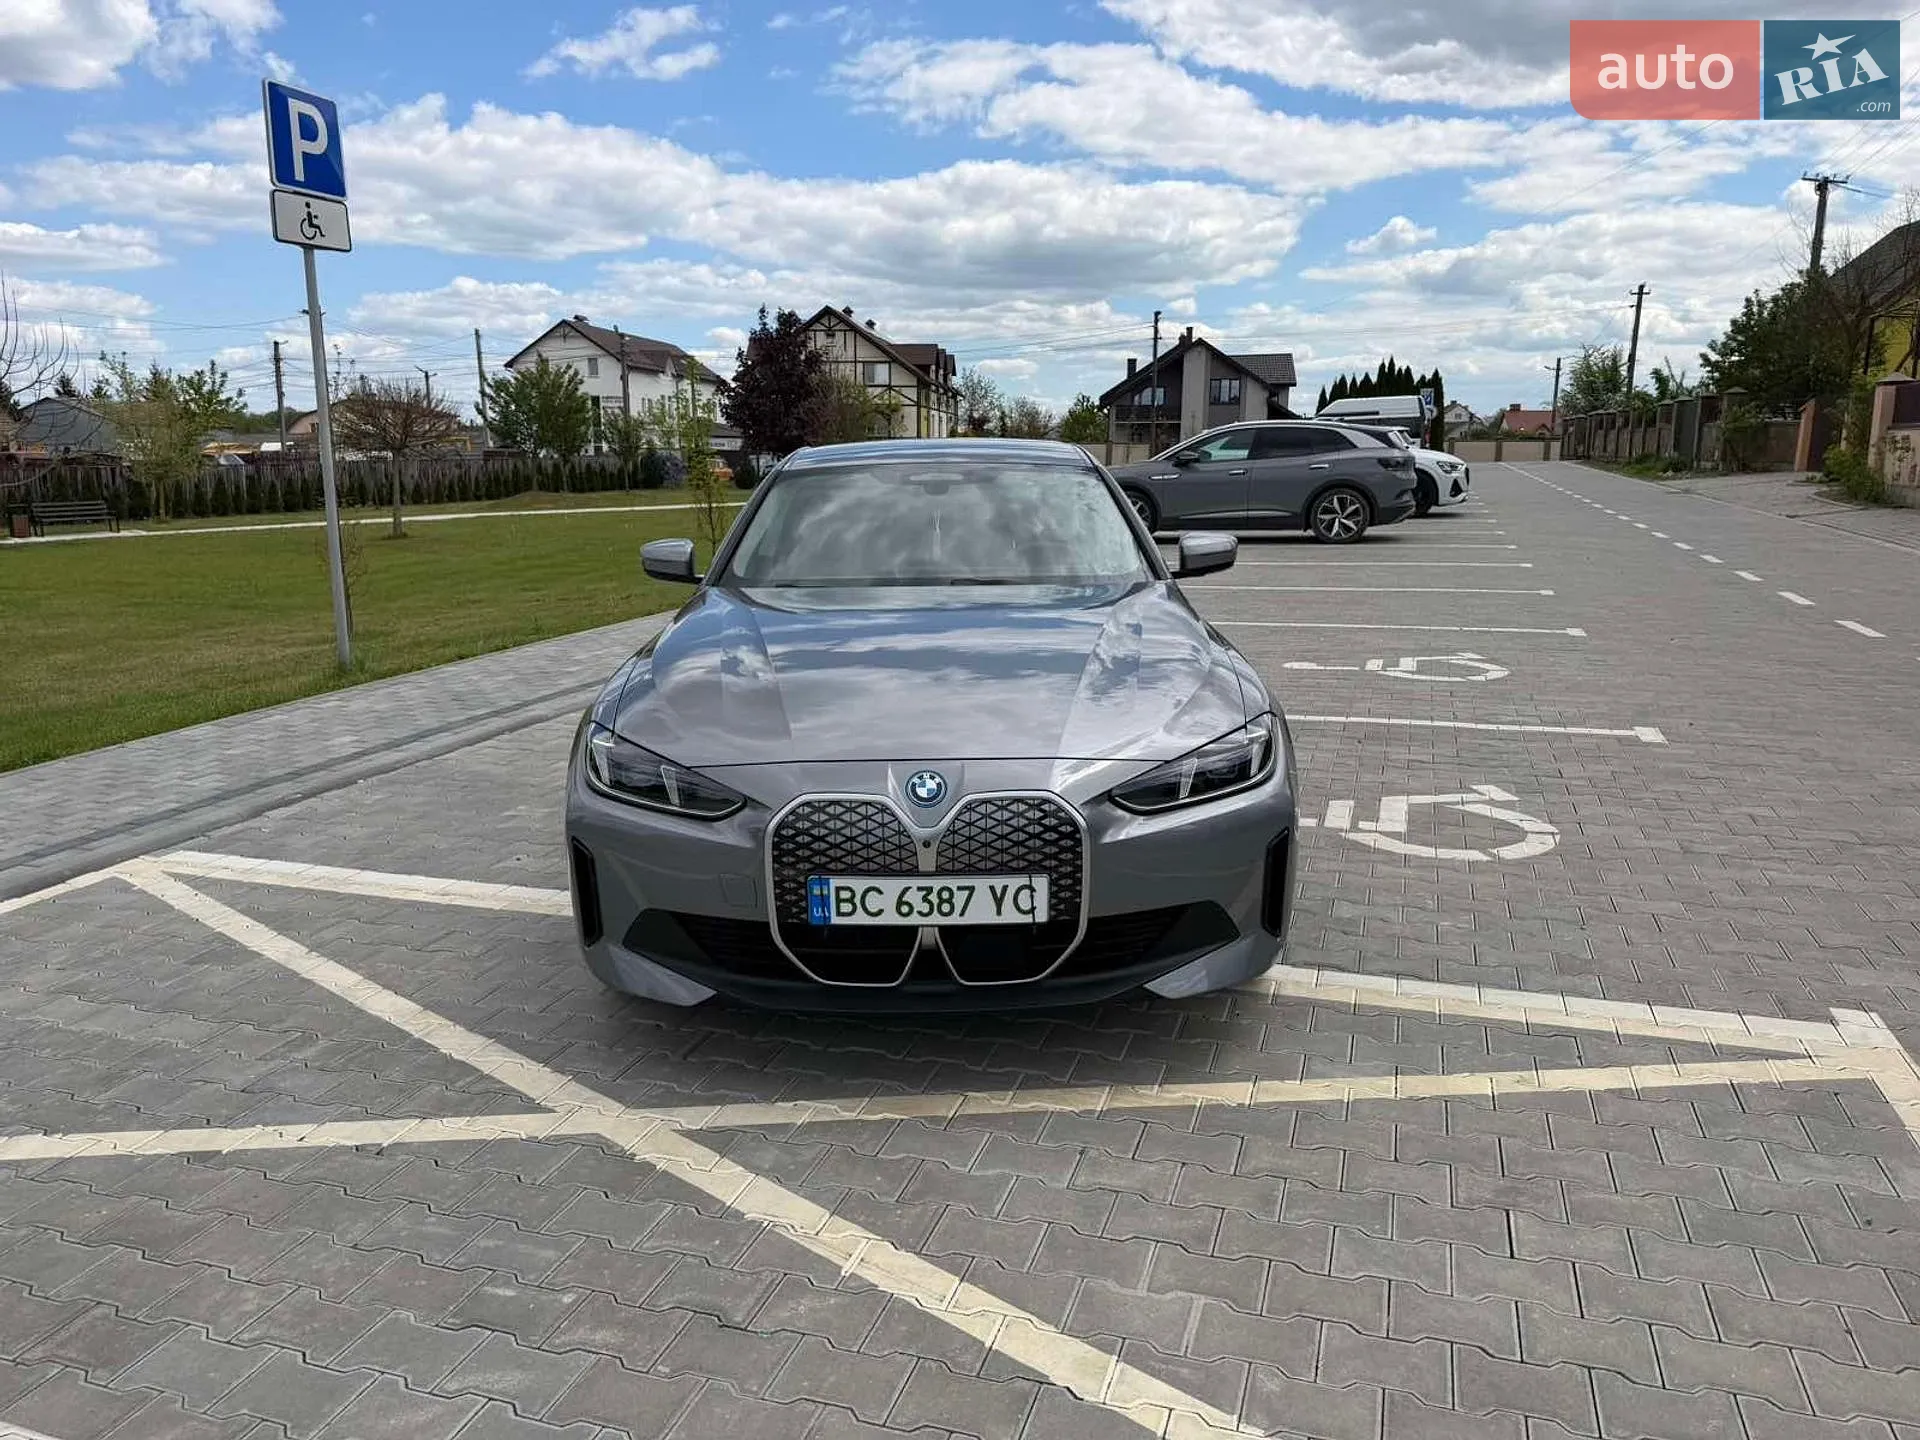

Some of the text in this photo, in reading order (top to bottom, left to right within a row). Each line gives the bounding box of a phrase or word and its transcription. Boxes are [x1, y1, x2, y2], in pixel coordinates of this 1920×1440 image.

[288, 97, 328, 182] P
[835, 884, 1036, 917] BC 6387 YC
